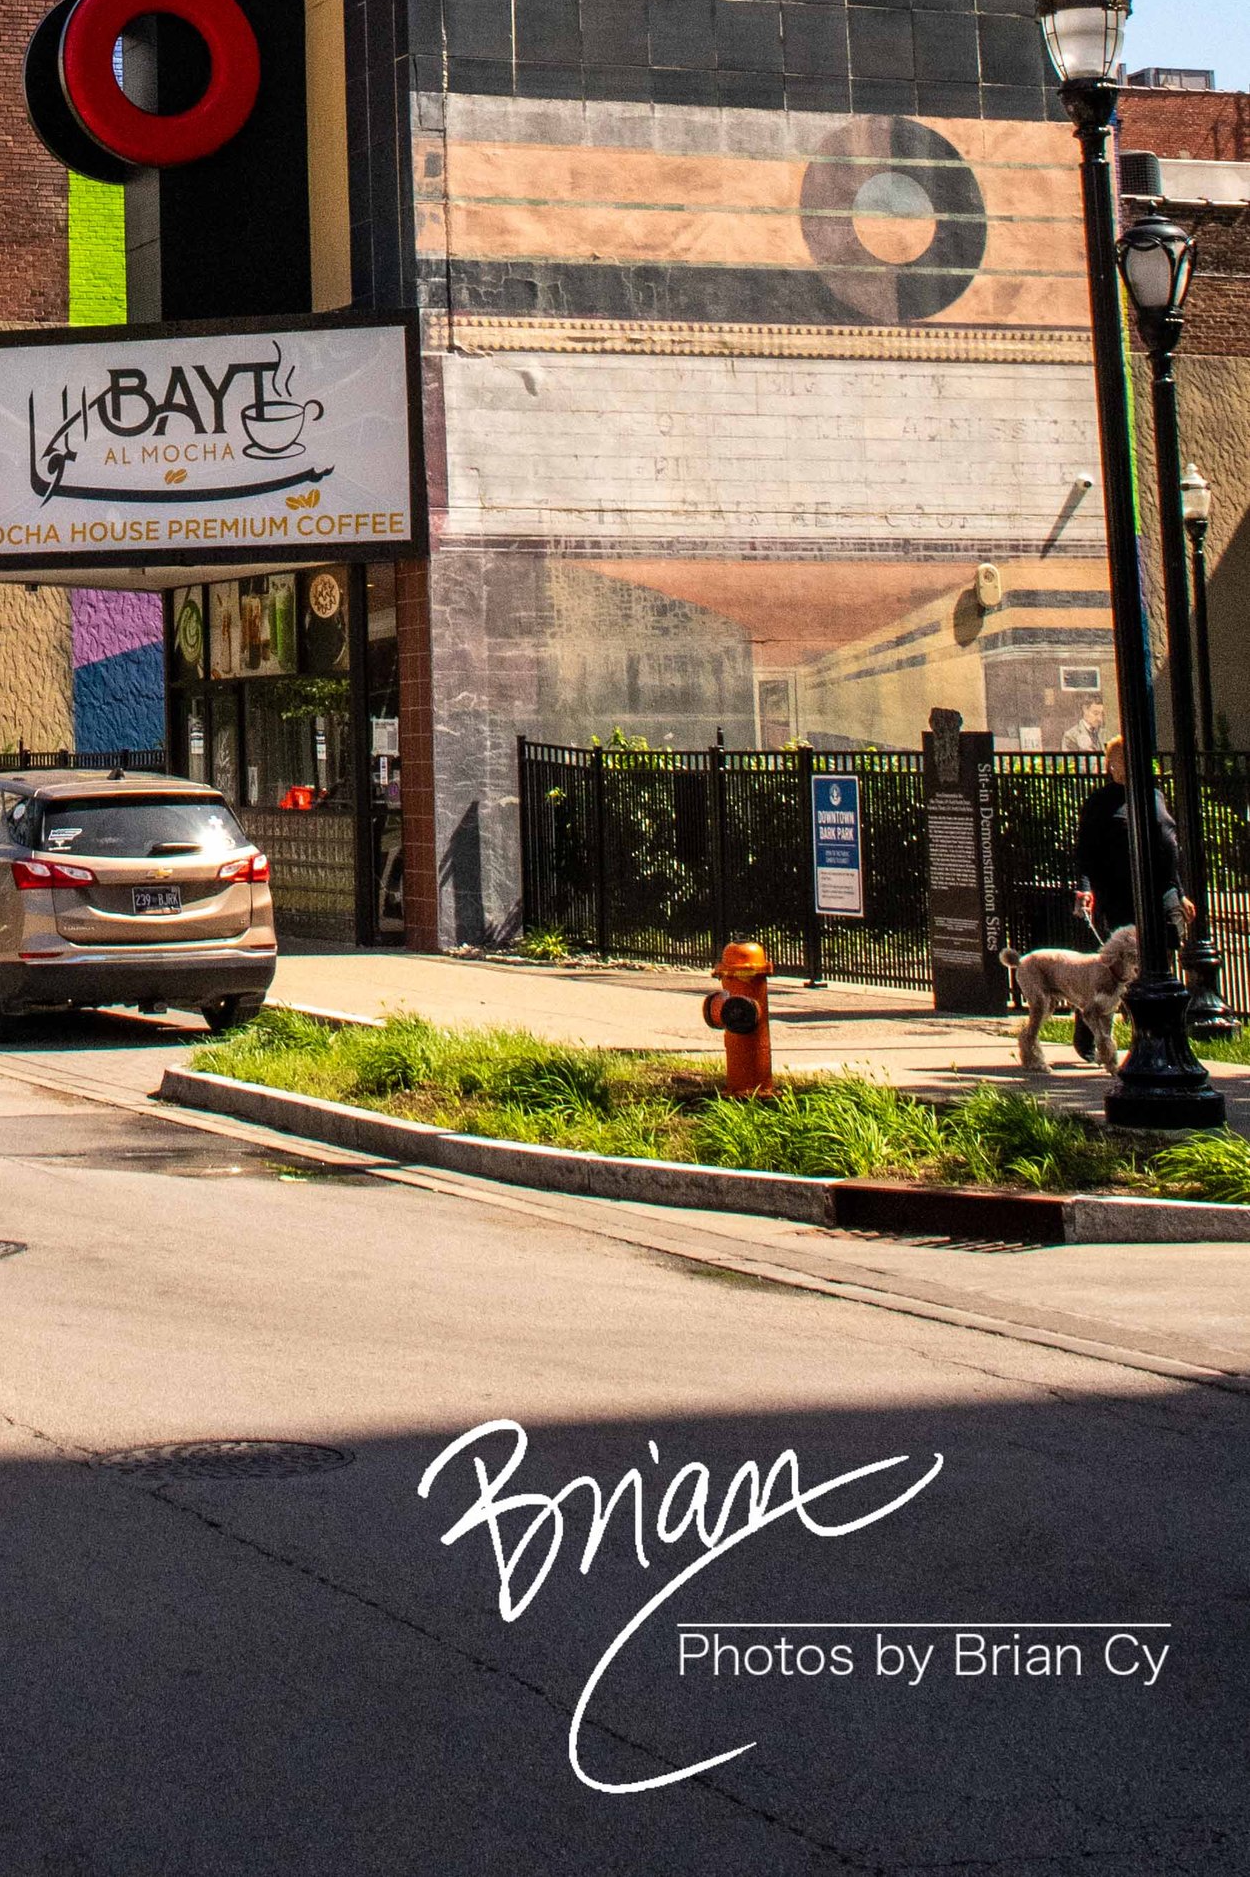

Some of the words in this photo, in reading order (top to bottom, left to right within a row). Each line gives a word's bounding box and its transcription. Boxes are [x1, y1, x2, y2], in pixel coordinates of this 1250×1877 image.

[98, 361, 280, 438] BAYT
[104, 446, 132, 466] AL
[141, 442, 236, 464] MOCHA
[70, 521, 160, 543] HOUSE
[168, 516, 288, 540] PREMIUM
[296, 513, 405, 537] COFFEE
[977, 763, 993, 802] Sit-in
[817, 810, 855, 825] DOWNTOWN
[819, 826, 836, 841] BARK
[837, 827, 855, 841] PARK
[980, 807, 999, 912] Demonstration
[135, 893, 151, 906] 239
[158, 893, 178, 906] BJRK
[986, 916, 1001, 952] Sites
